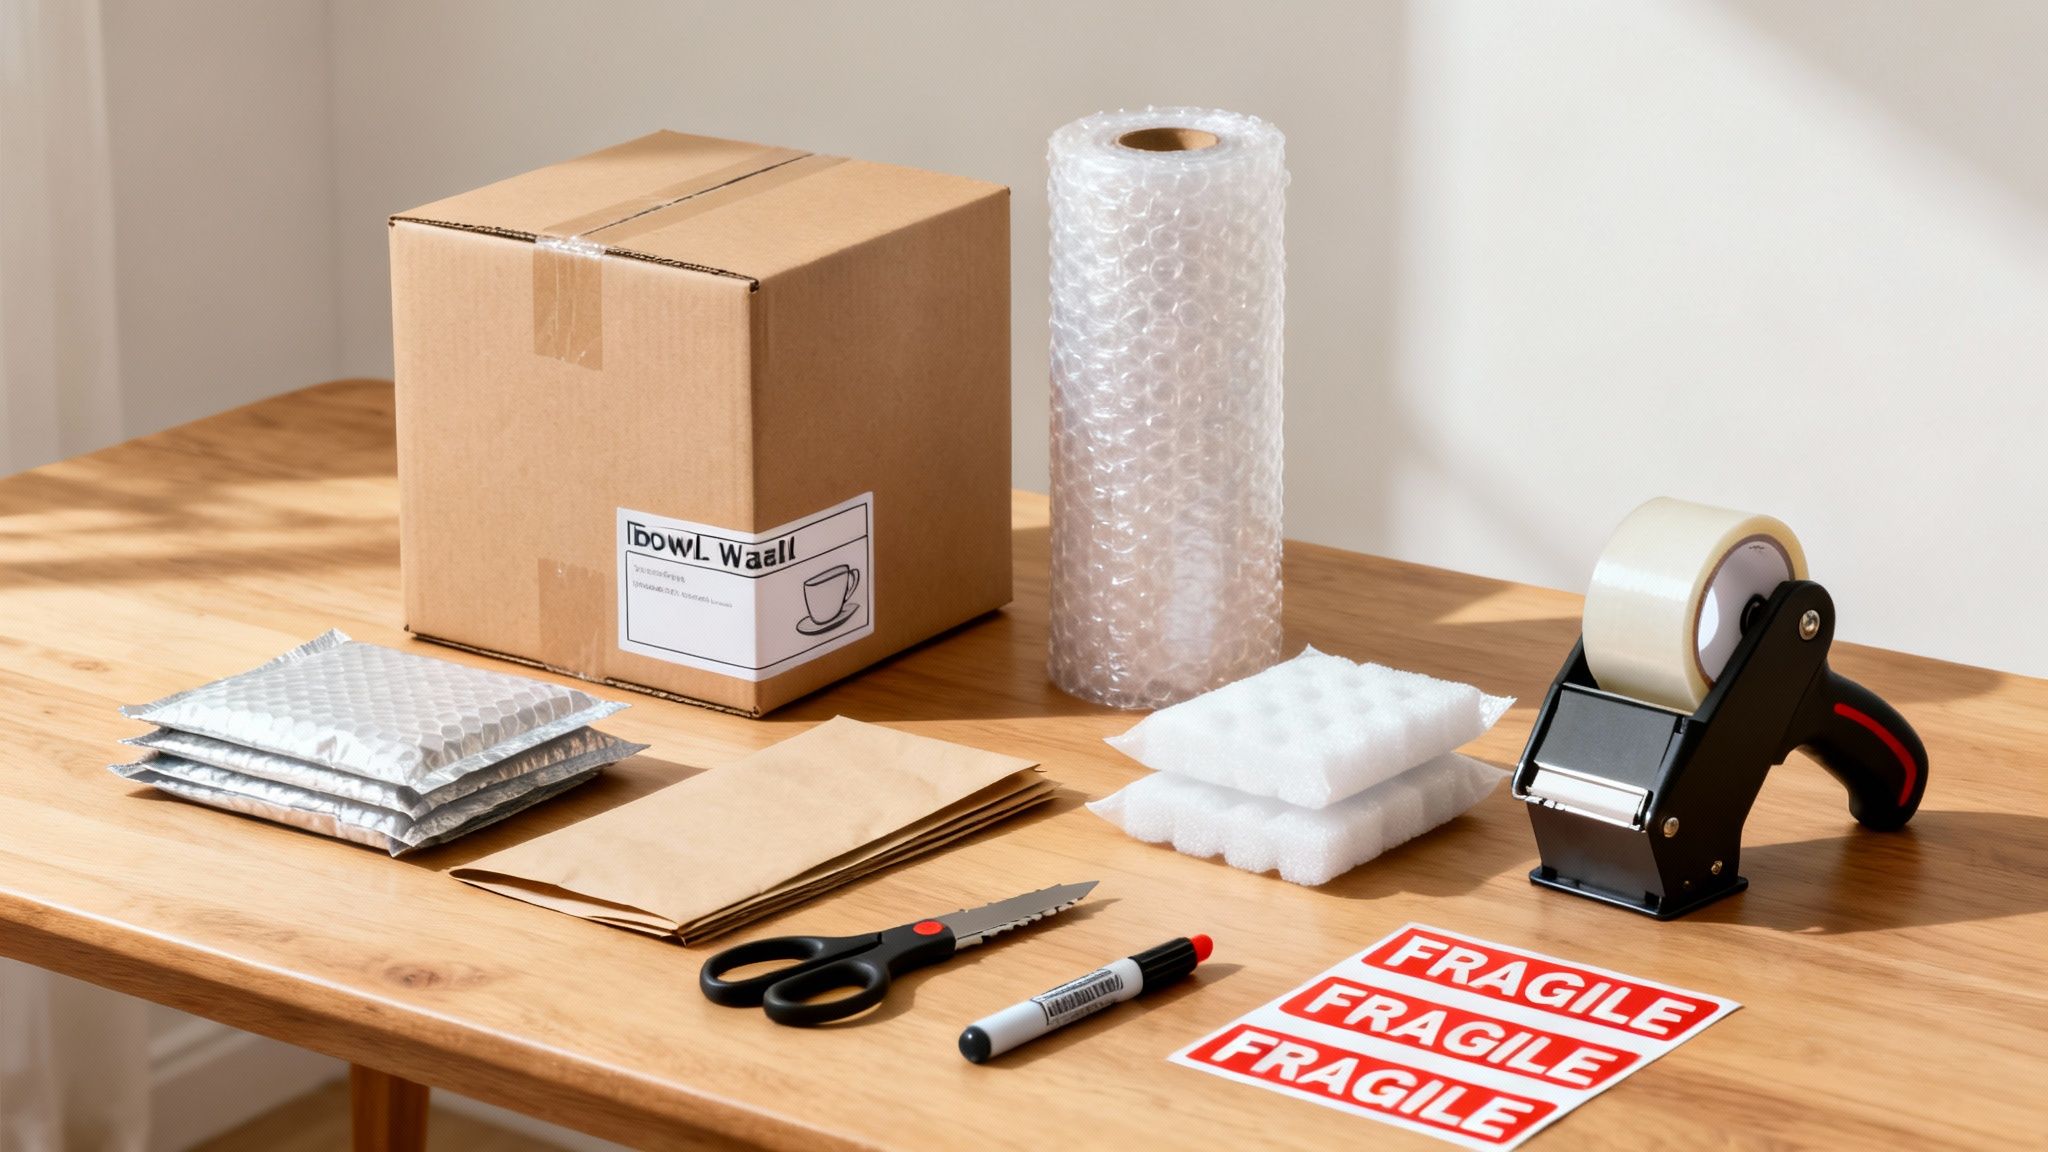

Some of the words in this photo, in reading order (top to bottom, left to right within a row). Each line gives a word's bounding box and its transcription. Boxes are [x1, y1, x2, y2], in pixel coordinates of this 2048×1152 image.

[1303, 983, 1618, 1087] FRAGILE
[1383, 935, 1697, 1036] FRAGILE
[1210, 1030, 1534, 1139] FRAGILE
